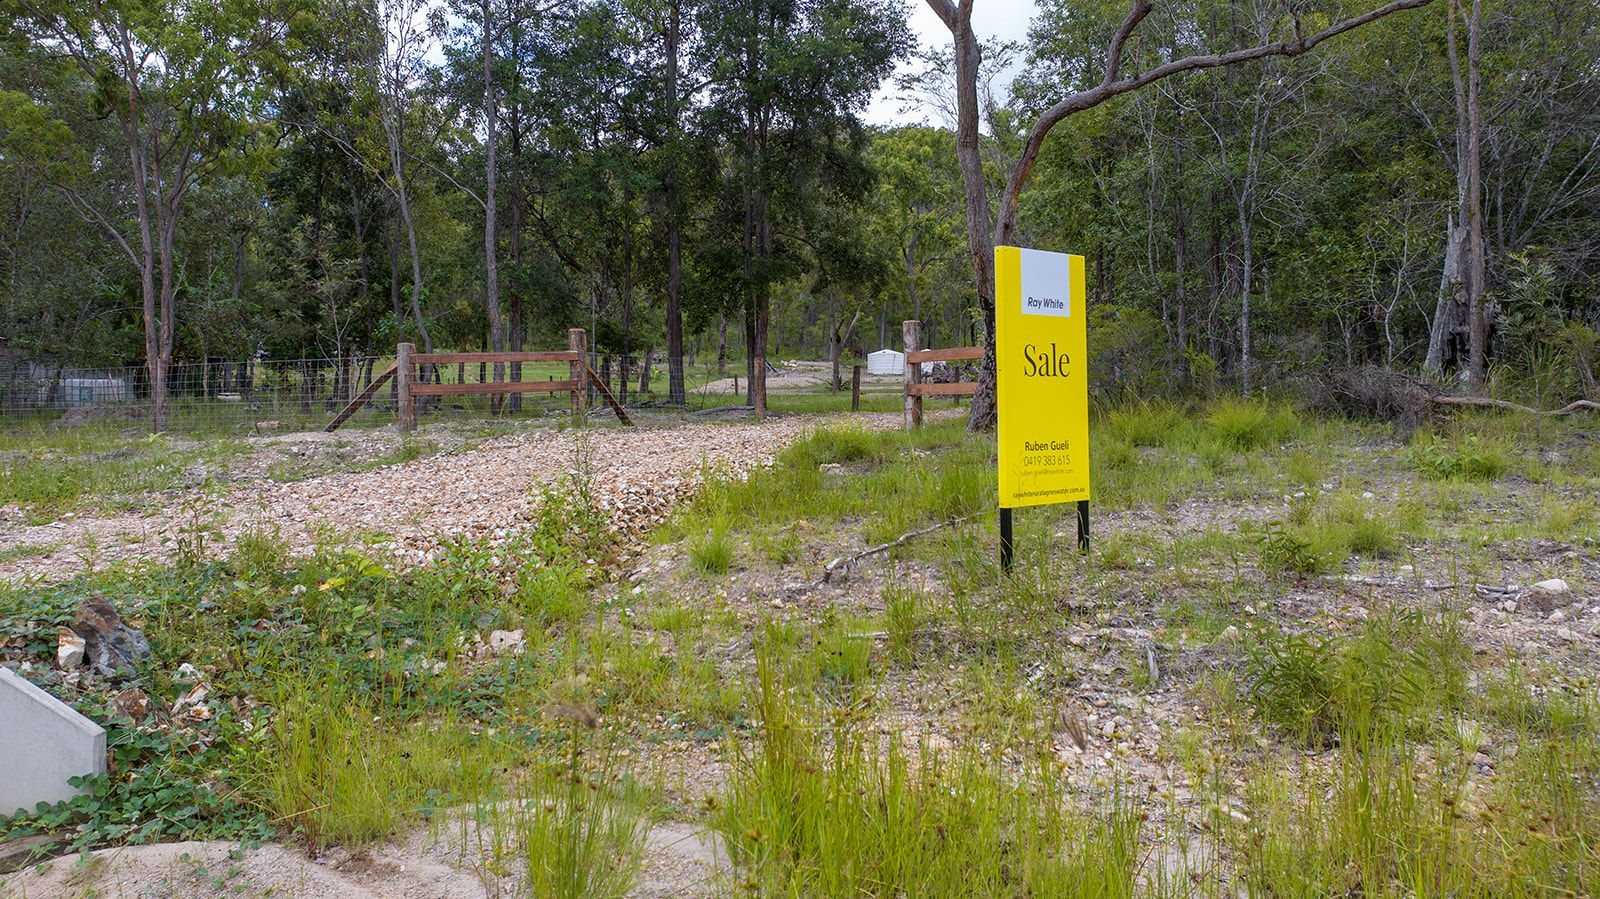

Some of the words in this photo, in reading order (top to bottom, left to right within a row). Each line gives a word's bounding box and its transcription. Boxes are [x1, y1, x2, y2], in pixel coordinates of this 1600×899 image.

[1027, 296, 1043, 309] Ray
[1043, 297, 1064, 309] White
[1024, 343, 1070, 377] Sale
[1024, 441, 1048, 451] Ruben
[1050, 440, 1070, 451] Gueli
[1024, 456, 1041, 466] 0419
[1043, 455, 1056, 465] 383
[1057, 455, 1070, 465] 615
